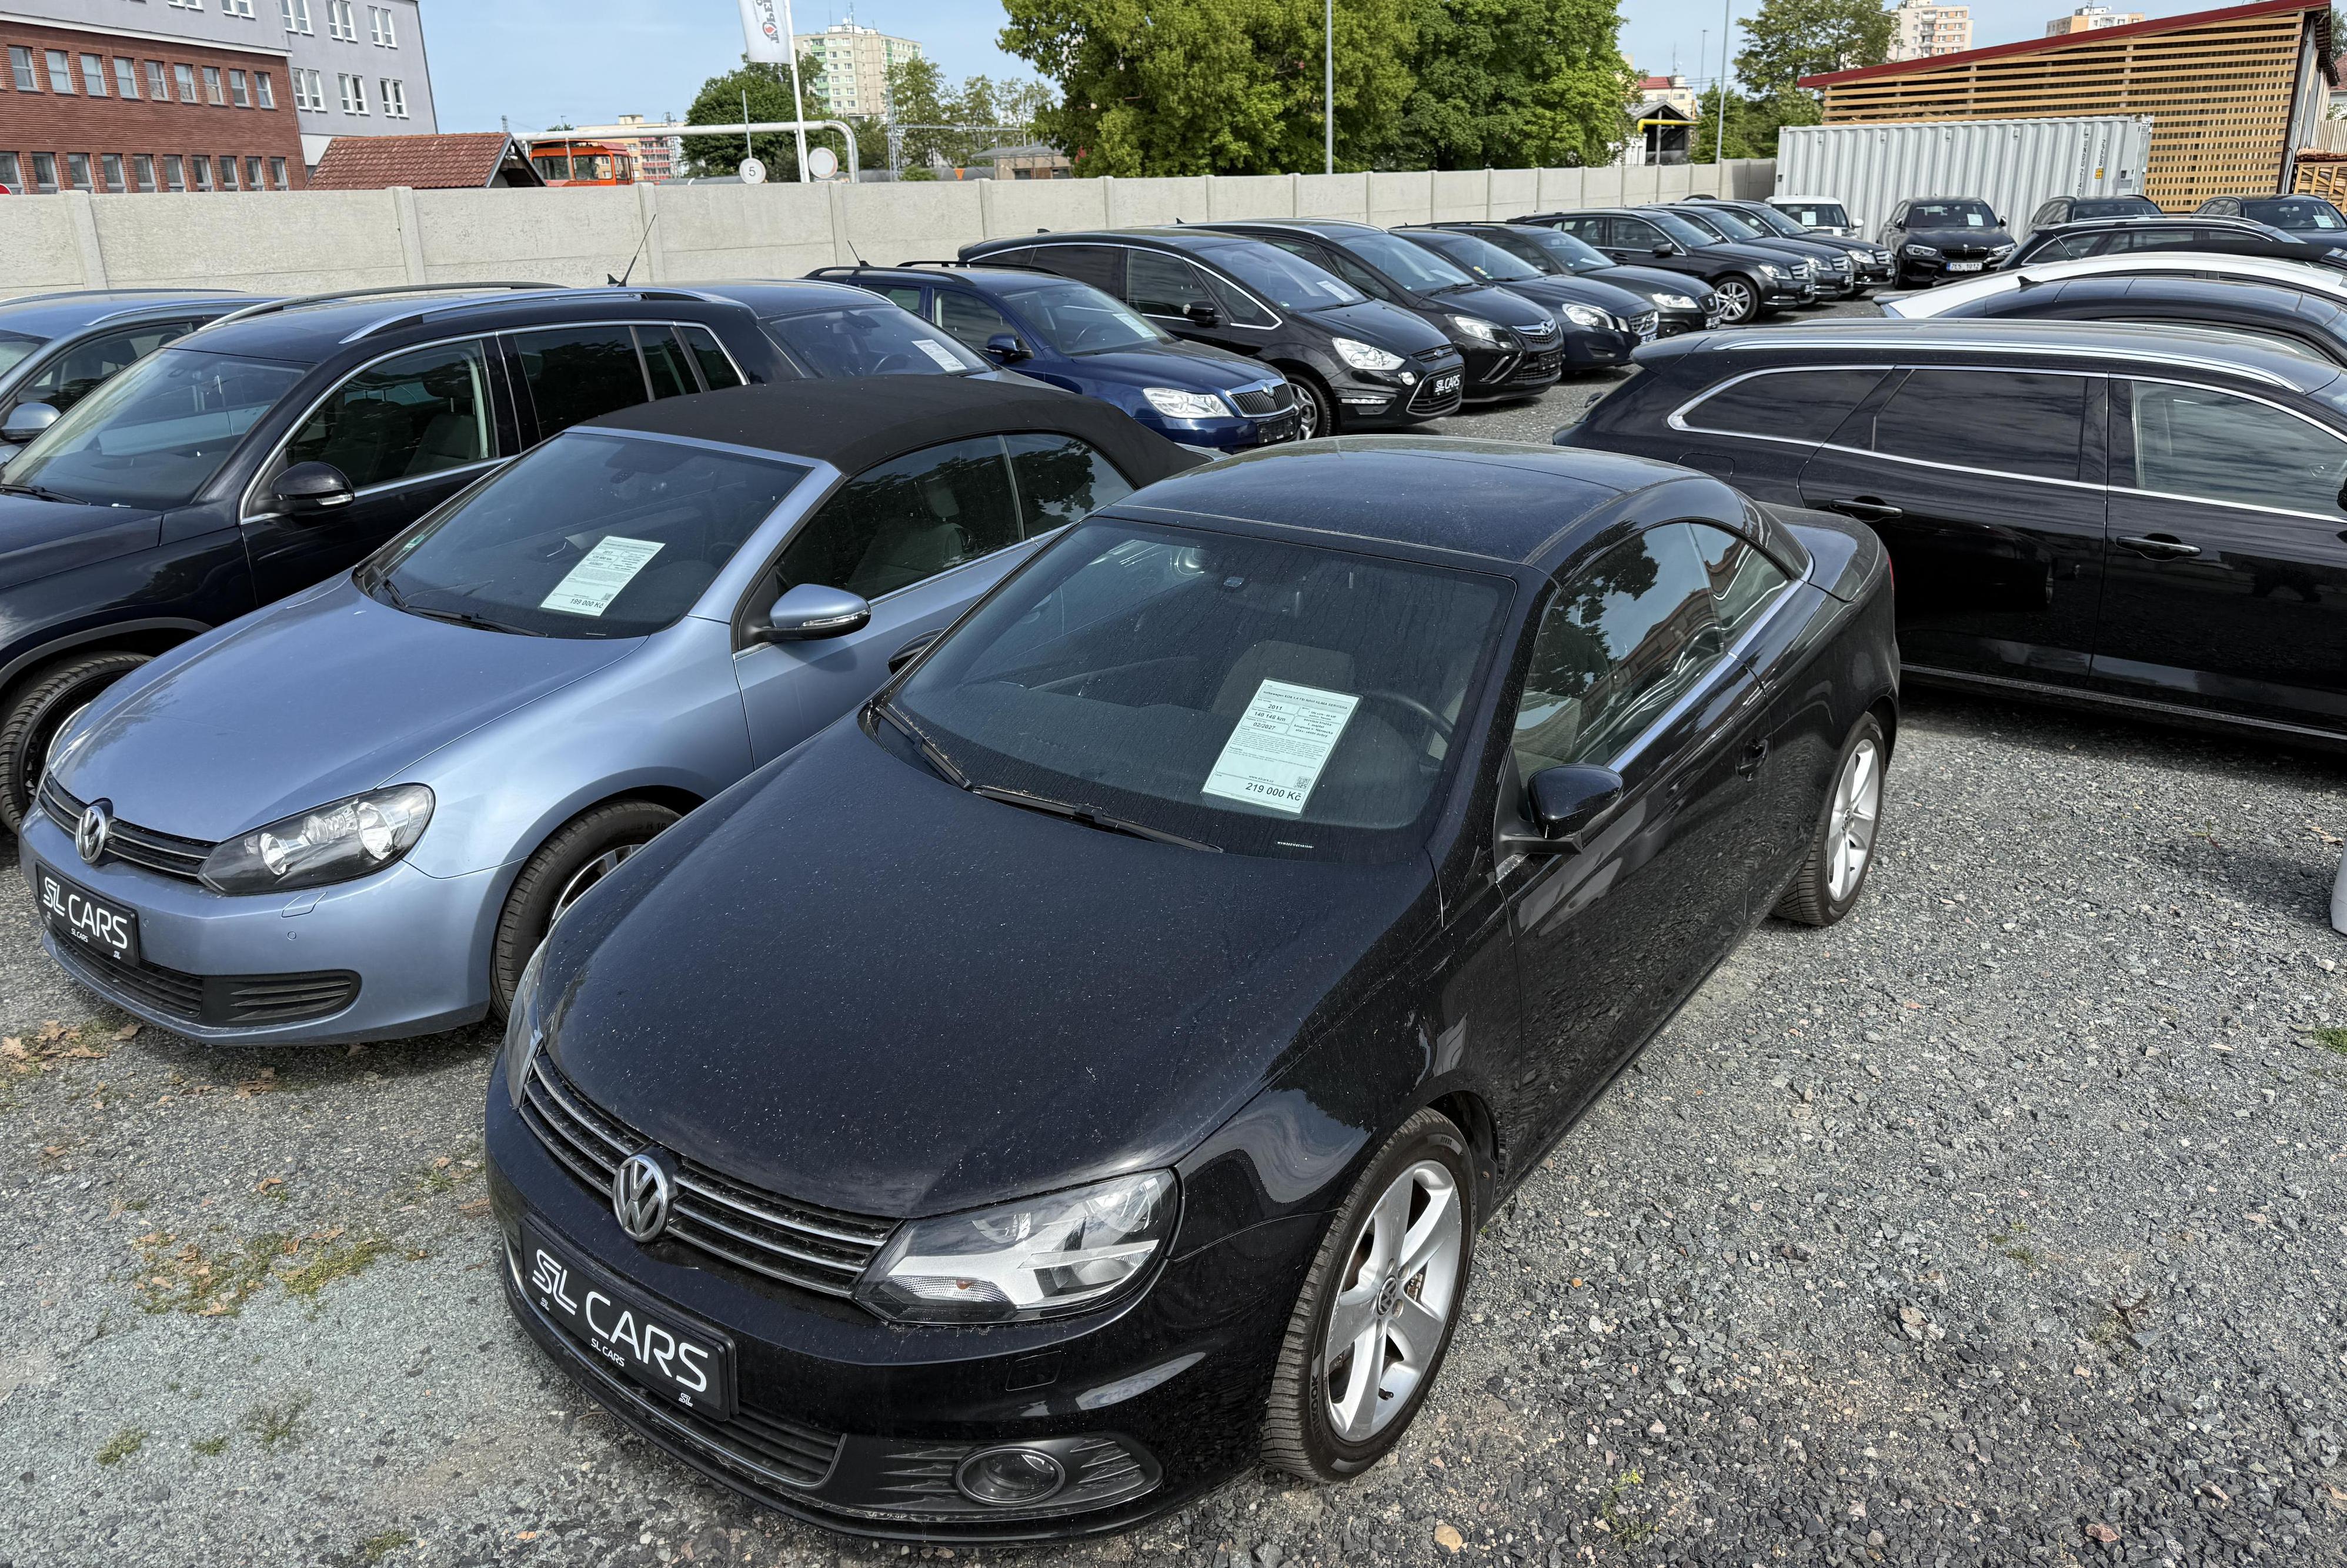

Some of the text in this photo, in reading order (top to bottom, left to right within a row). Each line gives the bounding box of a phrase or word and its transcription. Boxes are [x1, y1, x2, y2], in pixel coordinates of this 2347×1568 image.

[749, 167, 756, 176] 5
[1445, 375, 1460, 389] CARS
[1252, 721, 1276, 730] 02/2027
[1245, 782, 1303, 801] 219 000 Kč
[43, 877, 127, 949] SL CARS
[76, 932, 88, 942] CARS
[532, 1249, 708, 1392] SL CARS
[590, 1338, 625, 1368] SL CARS
